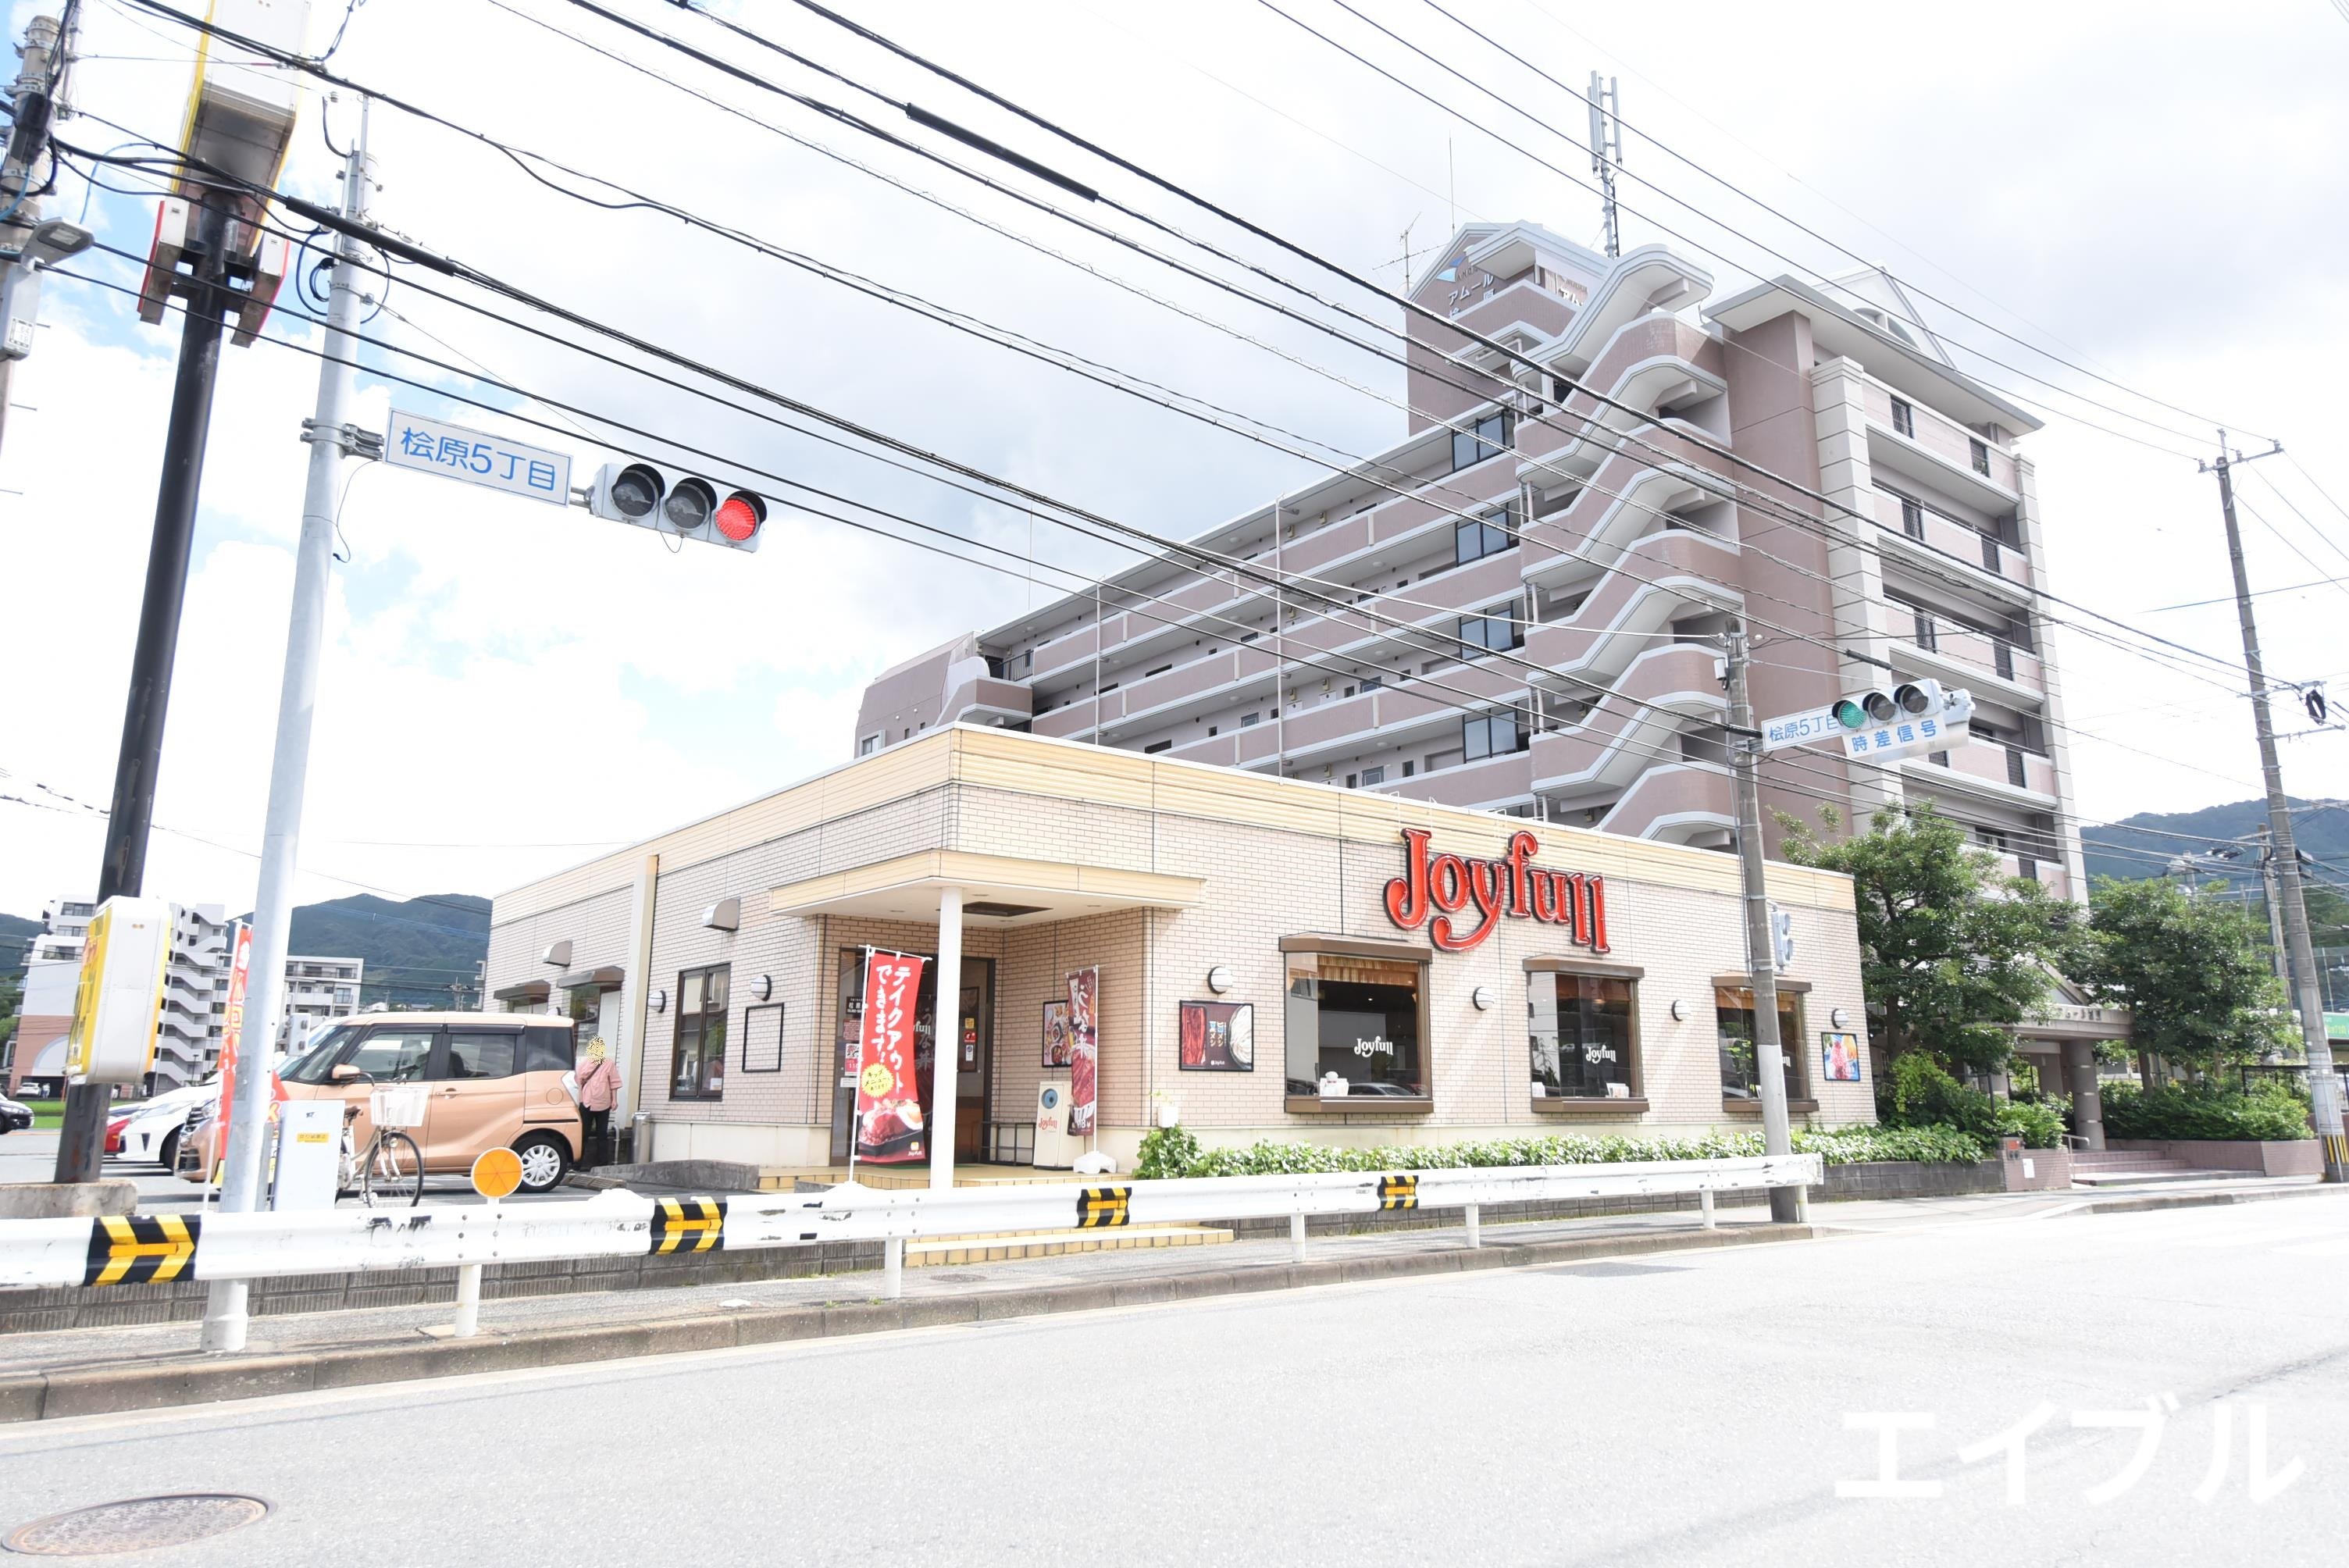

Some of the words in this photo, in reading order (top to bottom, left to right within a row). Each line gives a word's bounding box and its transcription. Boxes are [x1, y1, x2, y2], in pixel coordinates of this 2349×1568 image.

[1449, 273, 1494, 306] アムール
[401, 426, 556, 492] 桧原5丁目
[1852, 719, 1937, 752] 時差信号
[1383, 828, 1611, 953] Joyfull
[886, 966, 911, 1093] テイクアウト
[1353, 1035, 1394, 1058] Joyfull
[1585, 1044, 1616, 1064] Joyfull
[1039, 1116, 1058, 1130] Joyfull
